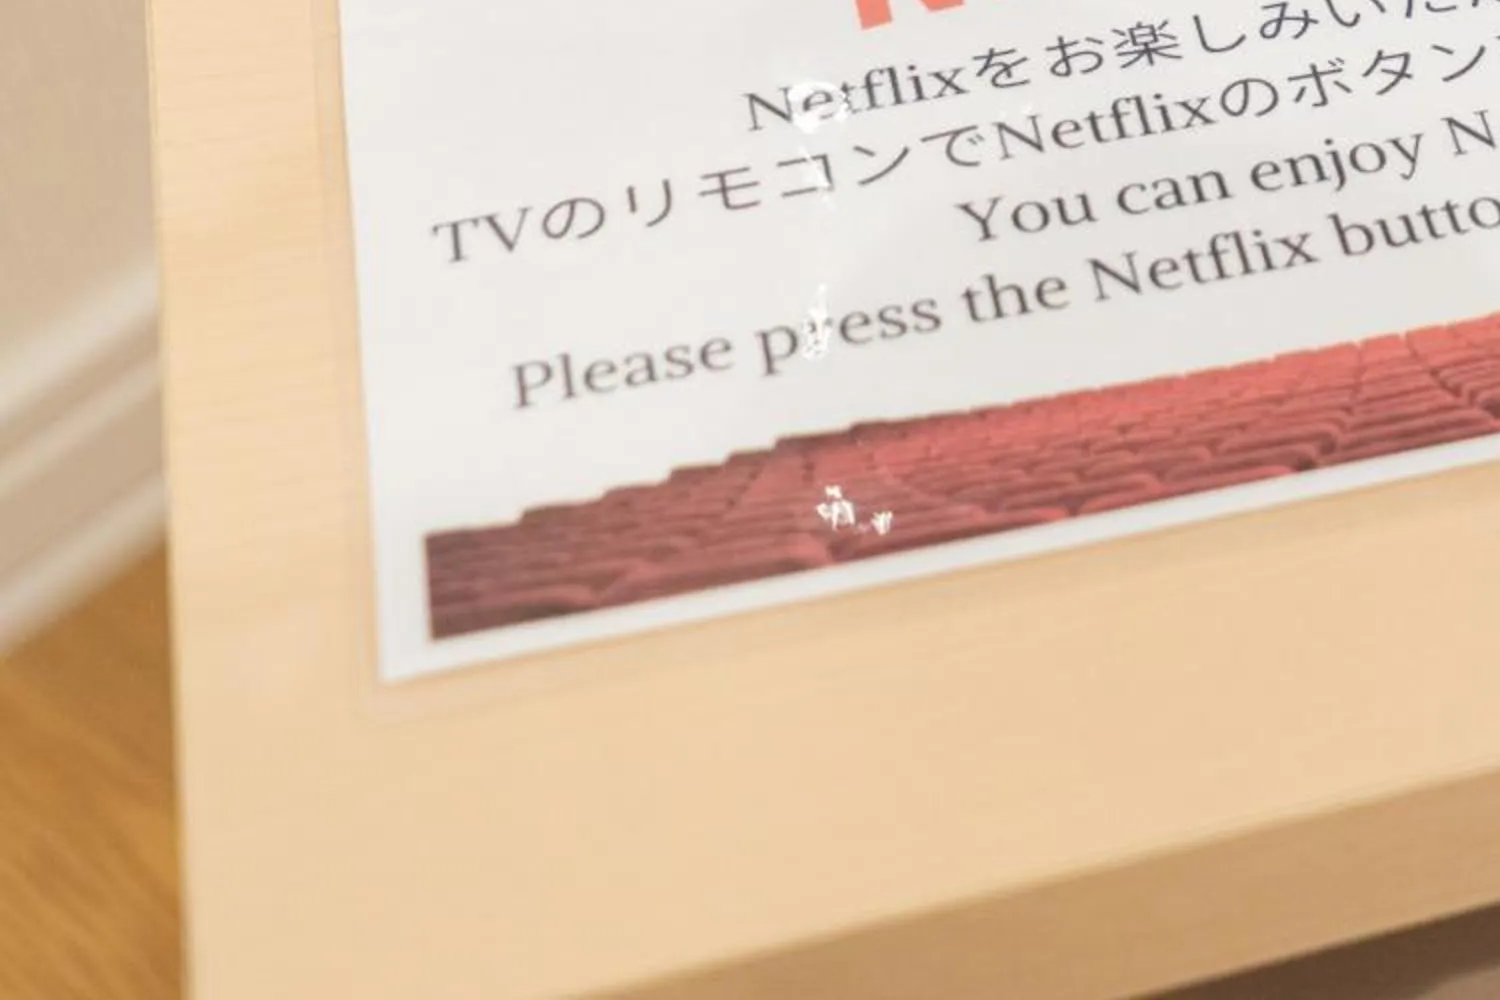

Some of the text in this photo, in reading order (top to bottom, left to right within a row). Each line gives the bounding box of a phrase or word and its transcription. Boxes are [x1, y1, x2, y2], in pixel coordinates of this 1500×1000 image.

[955, 184, 1098, 243] You
[1115, 158, 1232, 218] can
[1248, 130, 1426, 195] enjoy
[511, 336, 734, 408] Please
[960, 272, 1070, 326] the
[1087, 228, 1319, 304] Netflix
